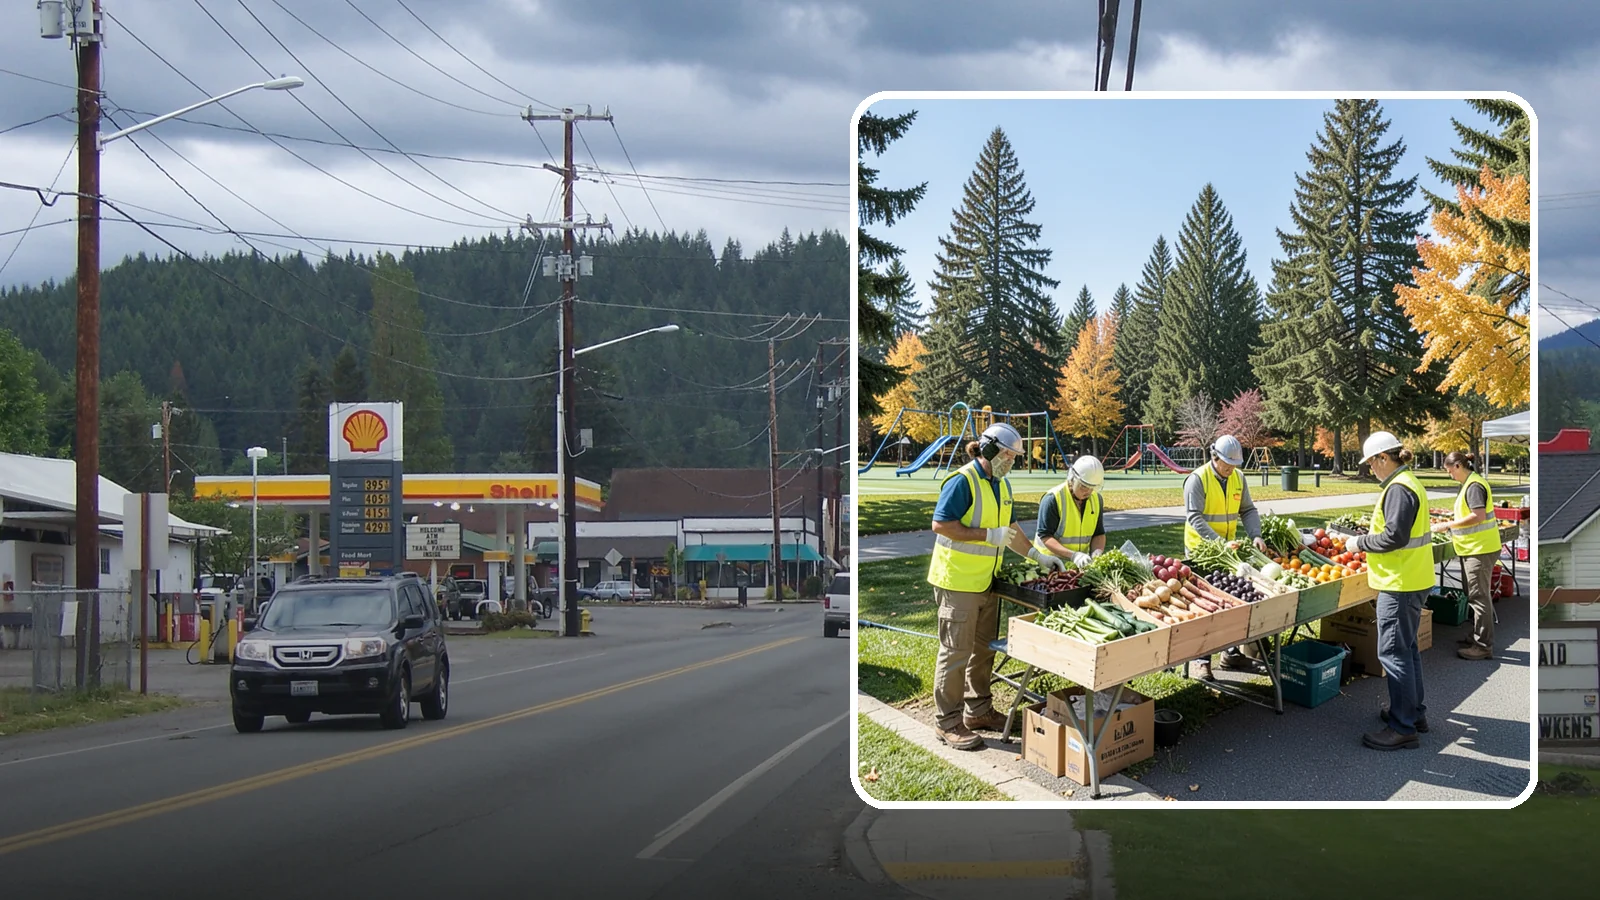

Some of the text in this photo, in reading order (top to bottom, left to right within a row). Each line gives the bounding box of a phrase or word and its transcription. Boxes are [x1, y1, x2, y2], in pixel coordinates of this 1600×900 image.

[366, 480, 384, 490] 395
[490, 484, 547, 499] Shell
[366, 494, 384, 504] 405
[366, 508, 383, 518] 415
[366, 522, 384, 532] 429
[1539, 642, 1566, 665] AID
